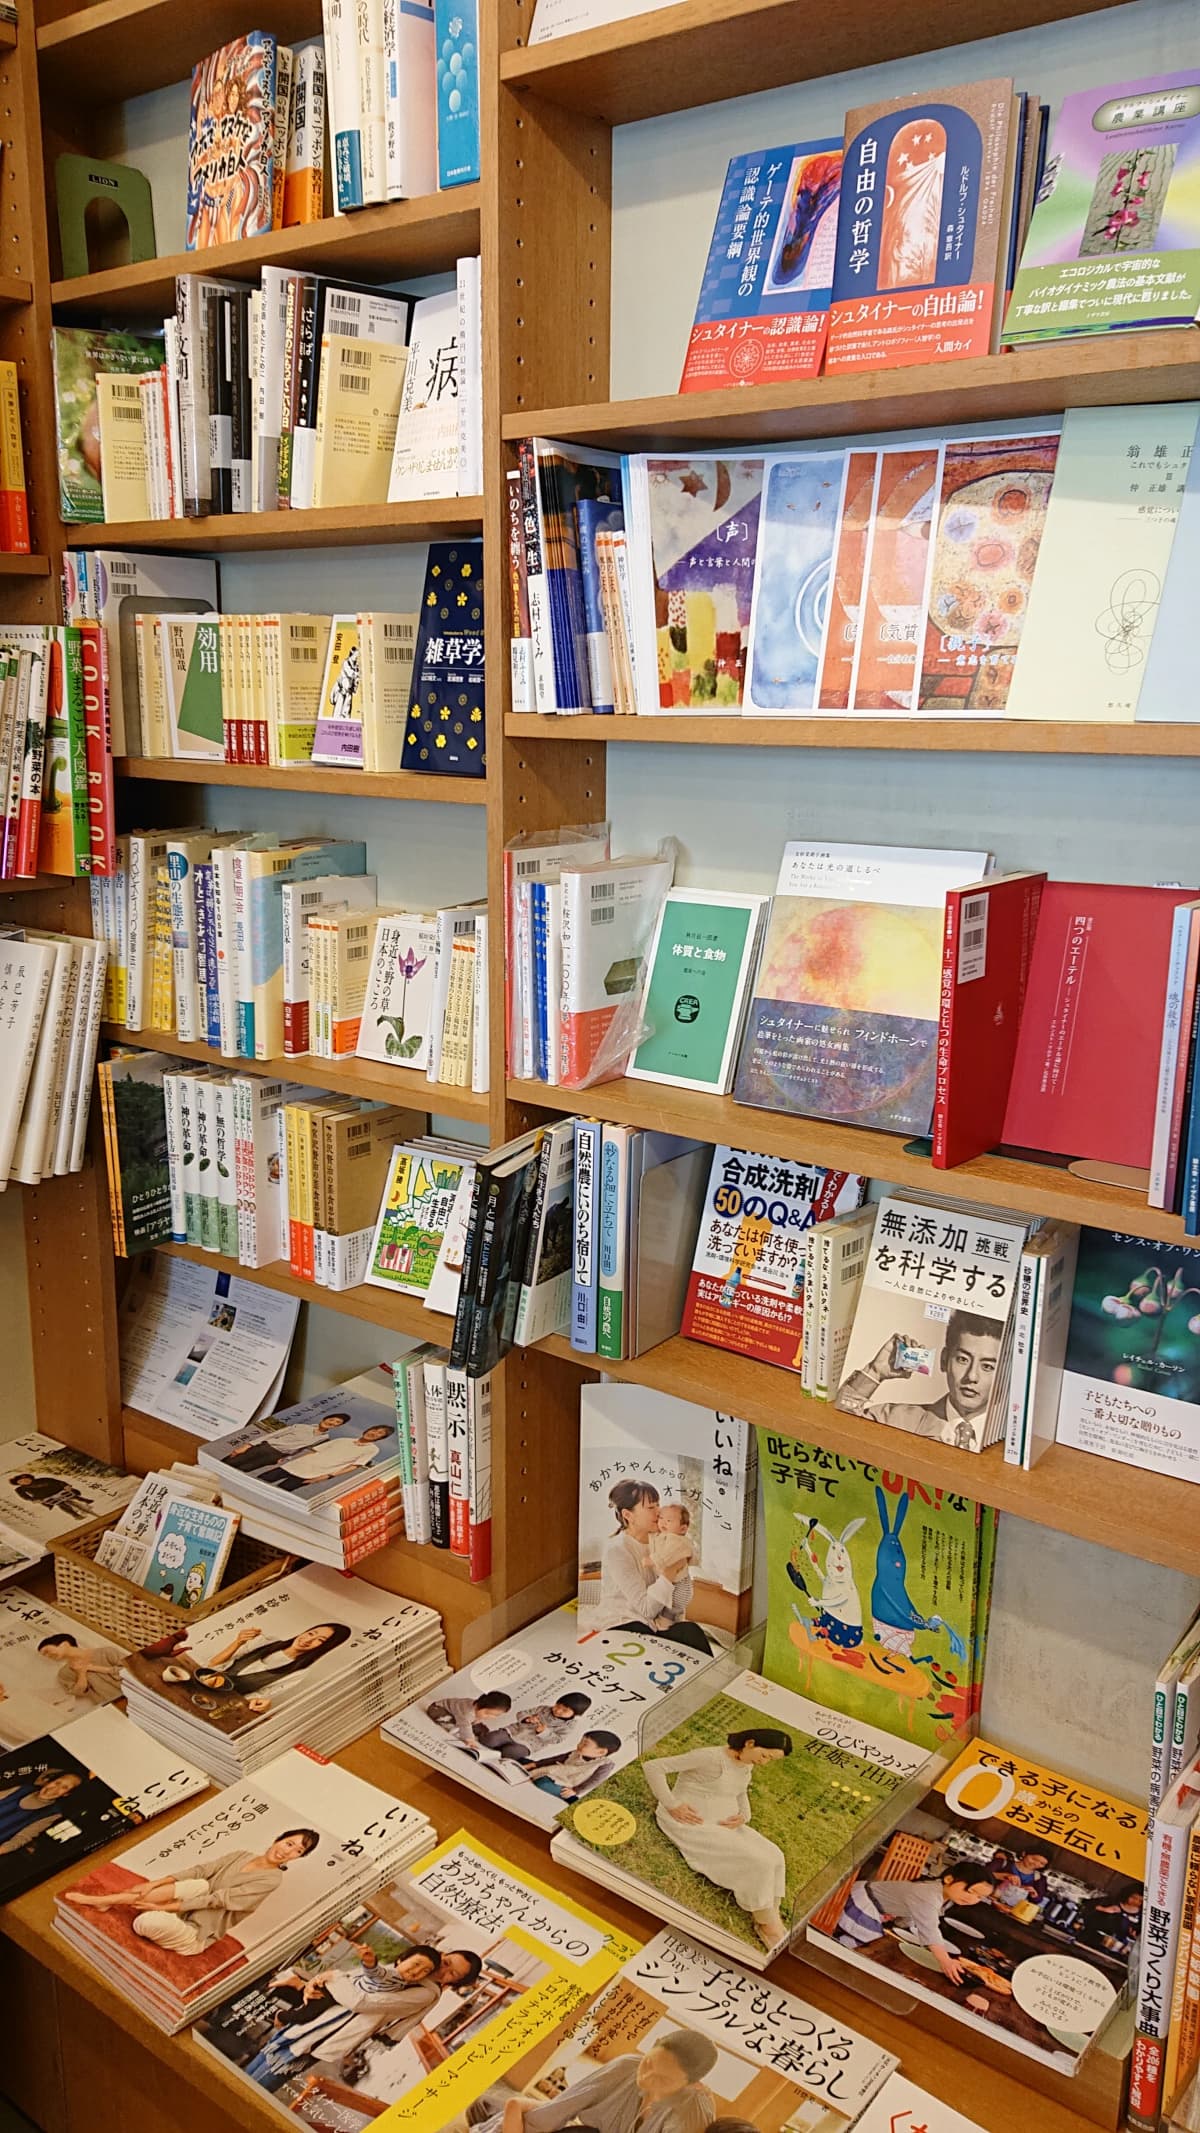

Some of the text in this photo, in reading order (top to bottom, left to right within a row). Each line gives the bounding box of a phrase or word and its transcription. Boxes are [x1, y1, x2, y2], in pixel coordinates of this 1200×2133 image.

[1112, 102, 1187, 124] 農業講座
[88, 174, 118, 188] LION
[194, 149, 246, 190] アメリカ白人
[726, 167, 760, 259] 認識論要綱
[737, 162, 783, 298] ゲーテ的世界観の
[848, 137, 878, 274] 自由の哲学
[954, 165, 970, 261] ルドルフ・シュタイナー
[1059, 258, 1161, 278] エコロジカルで宇宙的な
[690, 313, 825, 344] シュタイナーの認識論!
[829, 288, 985, 329] シュタイナーの自由論!
[425, 336, 459, 401] 病
[935, 338, 973, 355] 入間カイ
[172, 626, 186, 672] 野口晴哉
[198, 627, 218, 674] 効用
[67, 640, 88, 791] 野菜まるごと大図鑑
[82, 639, 106, 871] COOK BOOK
[168, 853, 185, 930] 里山の生態学
[370, 927, 390, 1011] 日本のこころ
[380, 927, 400, 1011] 身近な野の草
[672, 943, 727, 962] 体質と食物
[1064, 915, 1086, 985] 四つのエーテル
[759, 1014, 928, 1048] シュタイナーに魅せられ フィンドホーンで
[603, 1143, 617, 1238] 妙なる畑に立ちて
[722, 1157, 820, 1203] 合成洗剤
[576, 1132, 592, 1285] 自然農にいのち宿りて
[713, 1184, 817, 1232] 50のQ&A
[879, 1208, 1010, 1259] 無添加 挑戦
[706, 1235, 798, 1270] 洗っていますか?
[874, 1245, 1008, 1299] を科学する
[1020, 1266, 1033, 1316] 砂糖の世界史
[1121, 1352, 1186, 1374] レイチェル・カーソン
[447, 1380, 466, 1439] 黙示
[1081, 1407, 1183, 1441] 一番大切な贈りもの
[1084, 1389, 1157, 1418] 子どもたちへの
[449, 1450, 462, 1497] 真山仁
[770, 1462, 840, 1498] 子育て
[663, 1485, 734, 1531] オーガニック
[543, 1650, 648, 1705] からだケア
[817, 1726, 924, 1779] のびやかな
[976, 1748, 1152, 1836] できる子になる!
[339, 1806, 409, 1858] いいね
[1005, 1803, 1122, 1861] お手伝い
[417, 1873, 507, 1934] 自然療法
[440, 1858, 591, 1958] あかちゃんからの
[659, 1948, 689, 1975] Day
[1138, 1906, 1172, 2037] 野菜づくり大事典
[635, 1961, 850, 2102] シンプルな暮らし
[700, 1967, 853, 2063] 子どもとつくる
